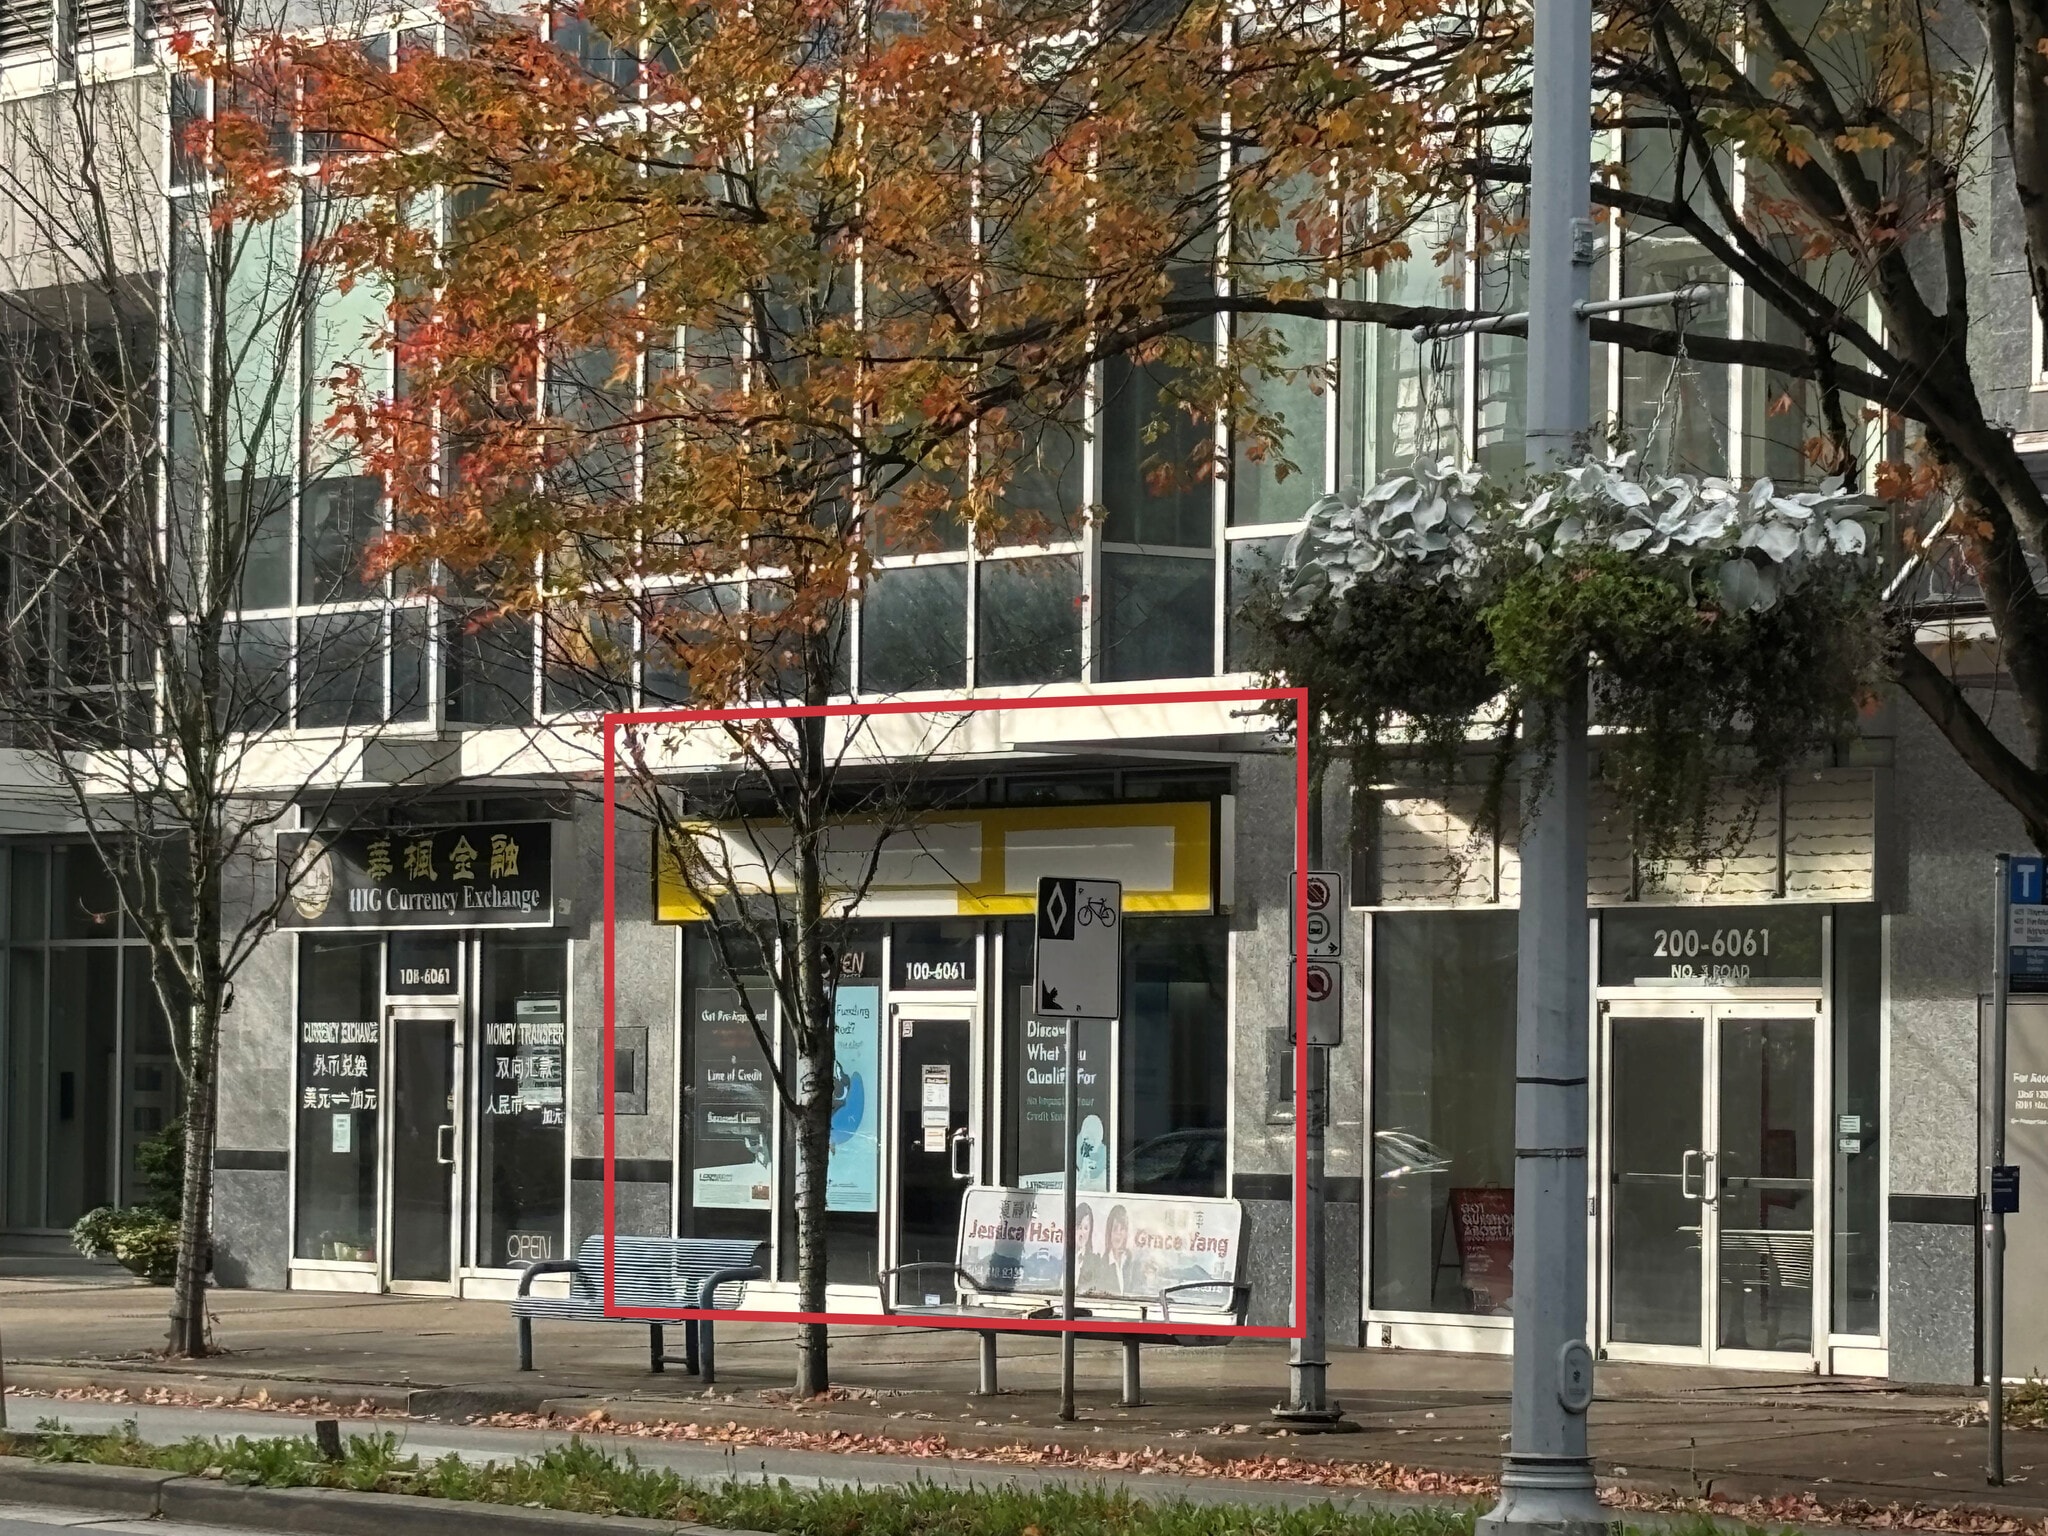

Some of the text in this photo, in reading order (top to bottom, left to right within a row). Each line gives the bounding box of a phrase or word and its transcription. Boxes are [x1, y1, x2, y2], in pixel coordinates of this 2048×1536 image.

[2017, 864, 2036, 897] T
[349, 885, 540, 914] HIG Currency Exchange
[1653, 928, 1769, 957] 200-6061
[906, 961, 966, 981] 100-6061
[303, 1022, 340, 1044] CURRENCY
[486, 1022, 565, 1046] MONEY TRANSFER
[1027, 1043, 1060, 1061] What
[968, 1218, 1026, 1243] Jessica
[1134, 1228, 1183, 1251] Grace
[506, 1234, 552, 1260] OPEN
